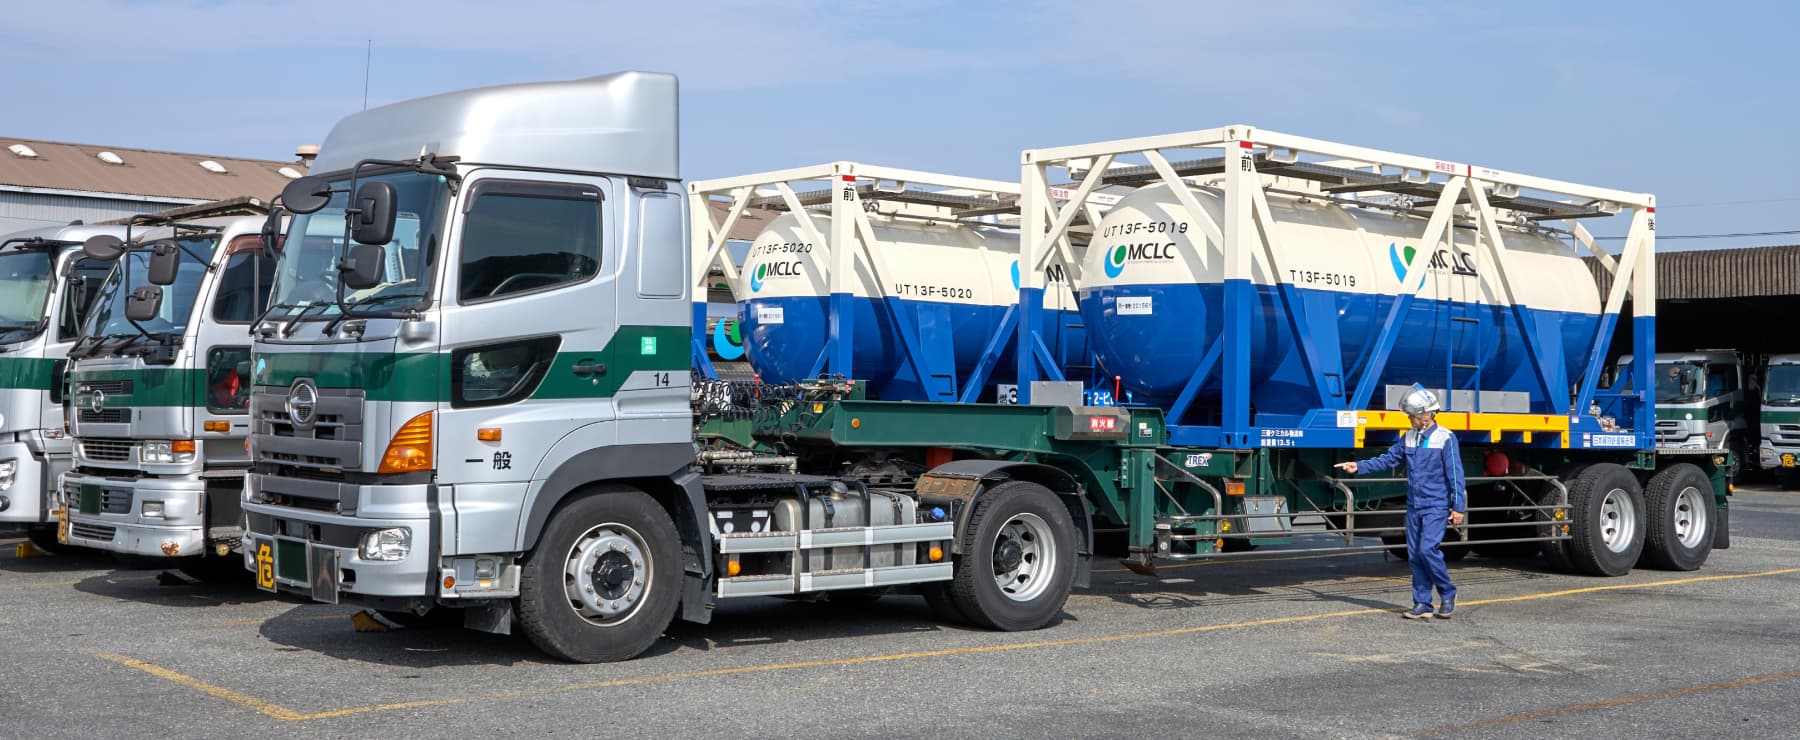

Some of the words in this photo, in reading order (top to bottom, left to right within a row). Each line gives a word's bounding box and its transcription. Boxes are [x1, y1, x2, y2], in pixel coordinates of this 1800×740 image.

[1240, 154, 1252, 172] 前
[843, 186, 855, 201] 前
[1104, 222, 1188, 238] UT13F-5019
[1128, 242, 1176, 260] MCLC
[766, 261, 803, 277] MCLC
[895, 283, 973, 299] UT13F-5020
[653, 372, 670, 387] 14
[465, 450, 512, 470] 一般
[1187, 455, 1209, 466] TREX
[256, 543, 274, 589] 危
